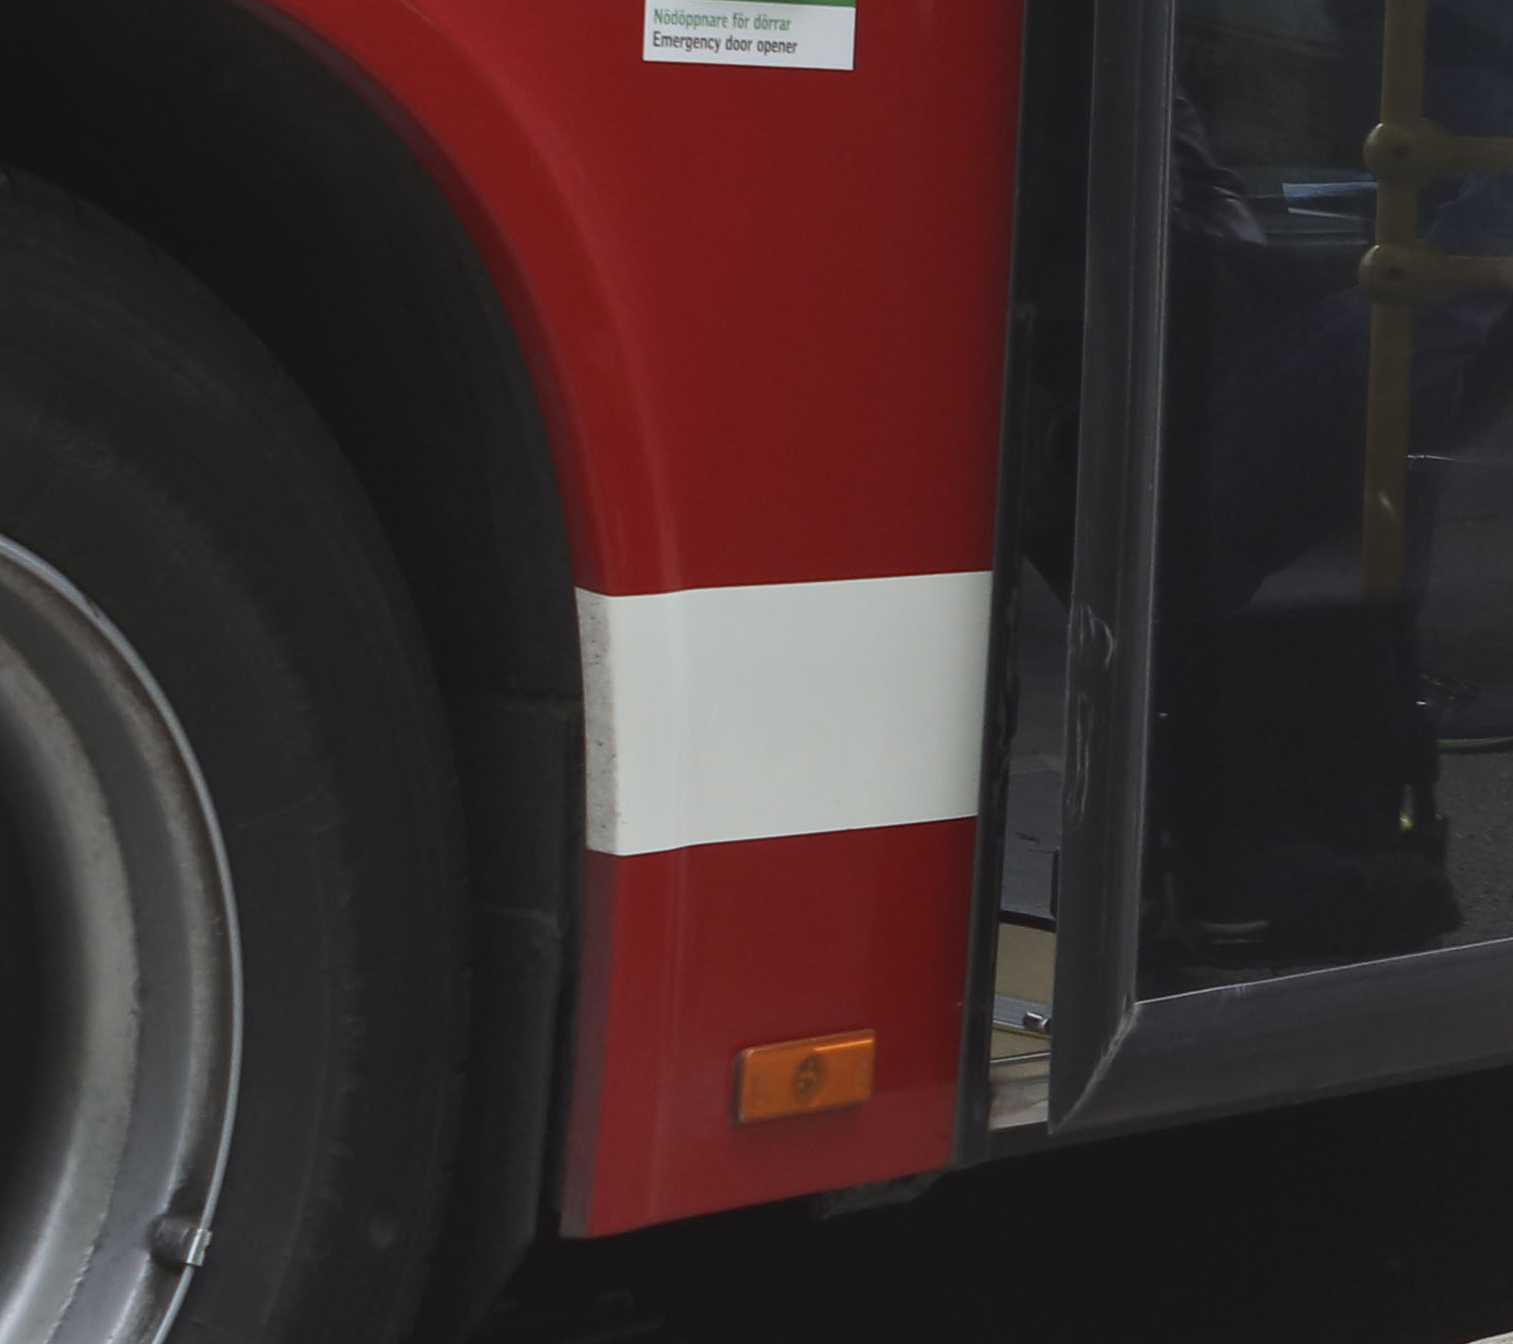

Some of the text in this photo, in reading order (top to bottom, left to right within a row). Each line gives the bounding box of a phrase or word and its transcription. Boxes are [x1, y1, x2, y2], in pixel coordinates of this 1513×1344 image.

[653, 8, 792, 32] Nödöppnare för dörrar
[652, 30, 798, 56] Emergency door opener
